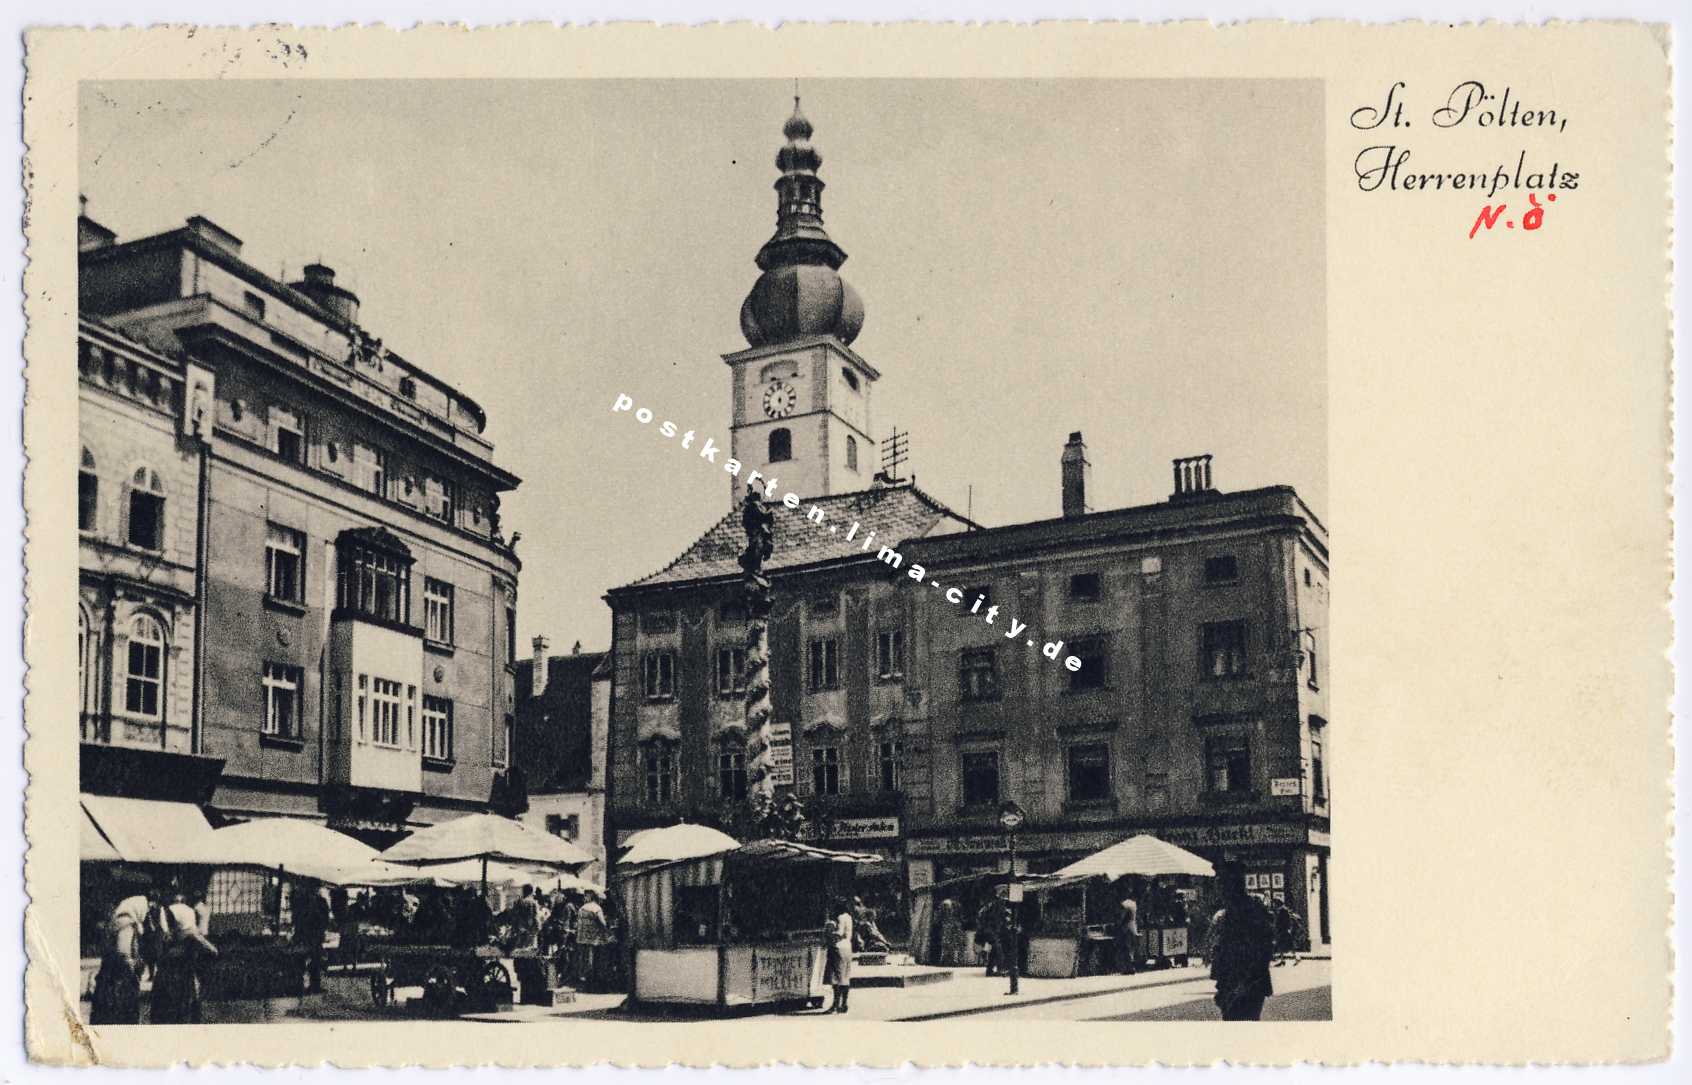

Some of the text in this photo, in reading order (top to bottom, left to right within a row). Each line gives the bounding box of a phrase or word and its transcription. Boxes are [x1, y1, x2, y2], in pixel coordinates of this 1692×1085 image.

[1350, 80, 1567, 133] St. Pölten,
[1354, 145, 1580, 198] Herrenplatz
